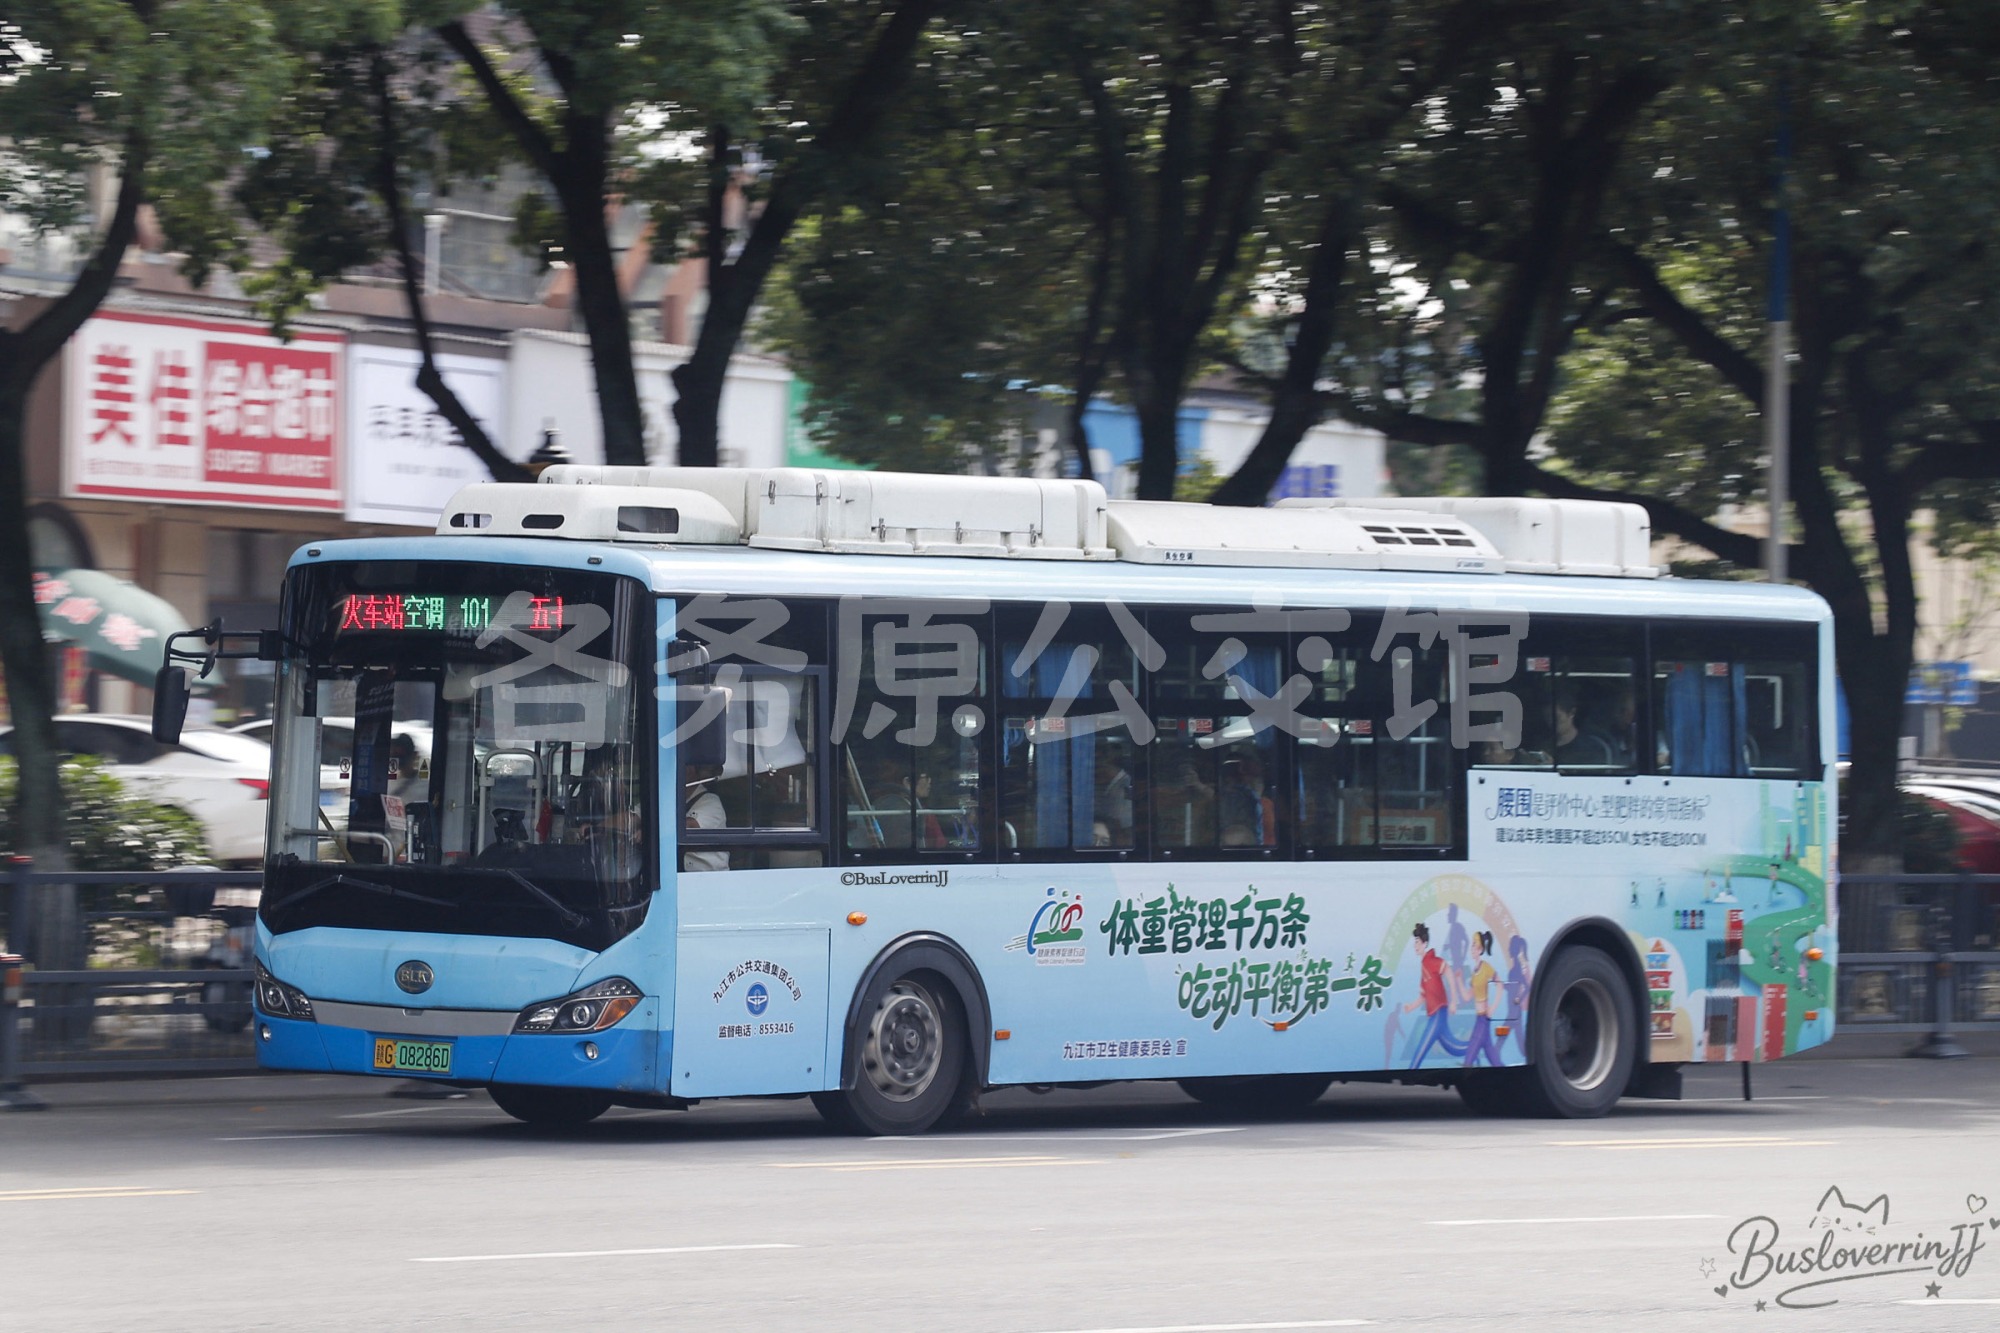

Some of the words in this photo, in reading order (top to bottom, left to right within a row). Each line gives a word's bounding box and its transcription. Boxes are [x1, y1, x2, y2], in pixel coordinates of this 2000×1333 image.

[205, 359, 336, 441] 综合超市
[460, 598, 490, 629] 101
[1100, 891, 1311, 956] 体重管理千万条
[713, 959, 802, 1003] 九江市公共交通集团公司
[1177, 955, 1392, 1030] 吃动平衡第一条
[1062, 1040, 1172, 1060] 九江市卫生健康委员会
